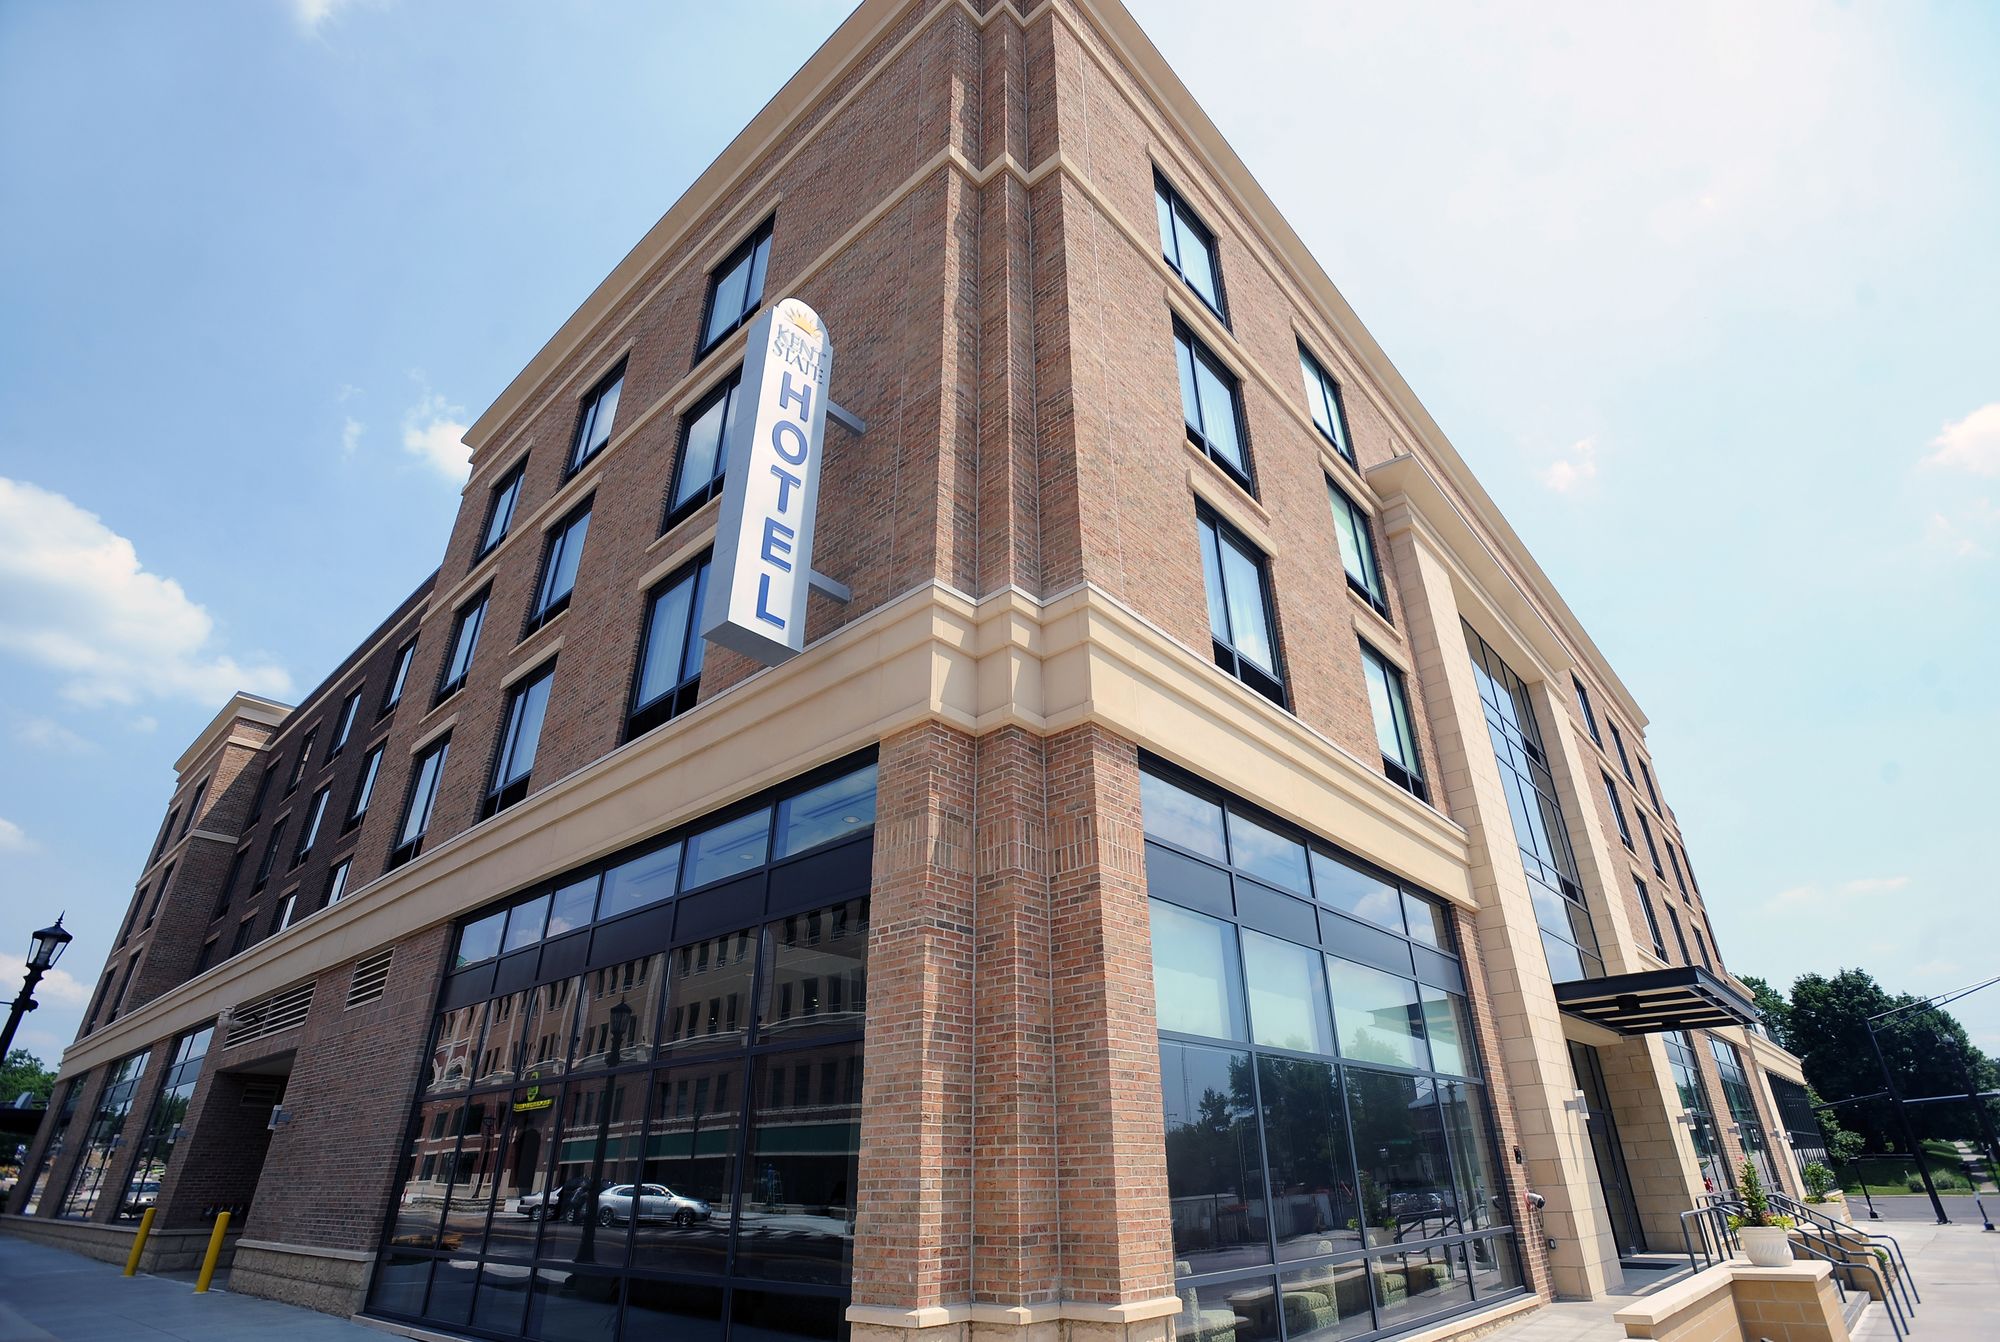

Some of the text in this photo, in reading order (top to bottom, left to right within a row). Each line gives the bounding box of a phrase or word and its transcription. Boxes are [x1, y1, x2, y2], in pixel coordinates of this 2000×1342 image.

[772, 340, 824, 385] STATE
[777, 324, 827, 367] KENT
[756, 371, 811, 630] HOTEL
